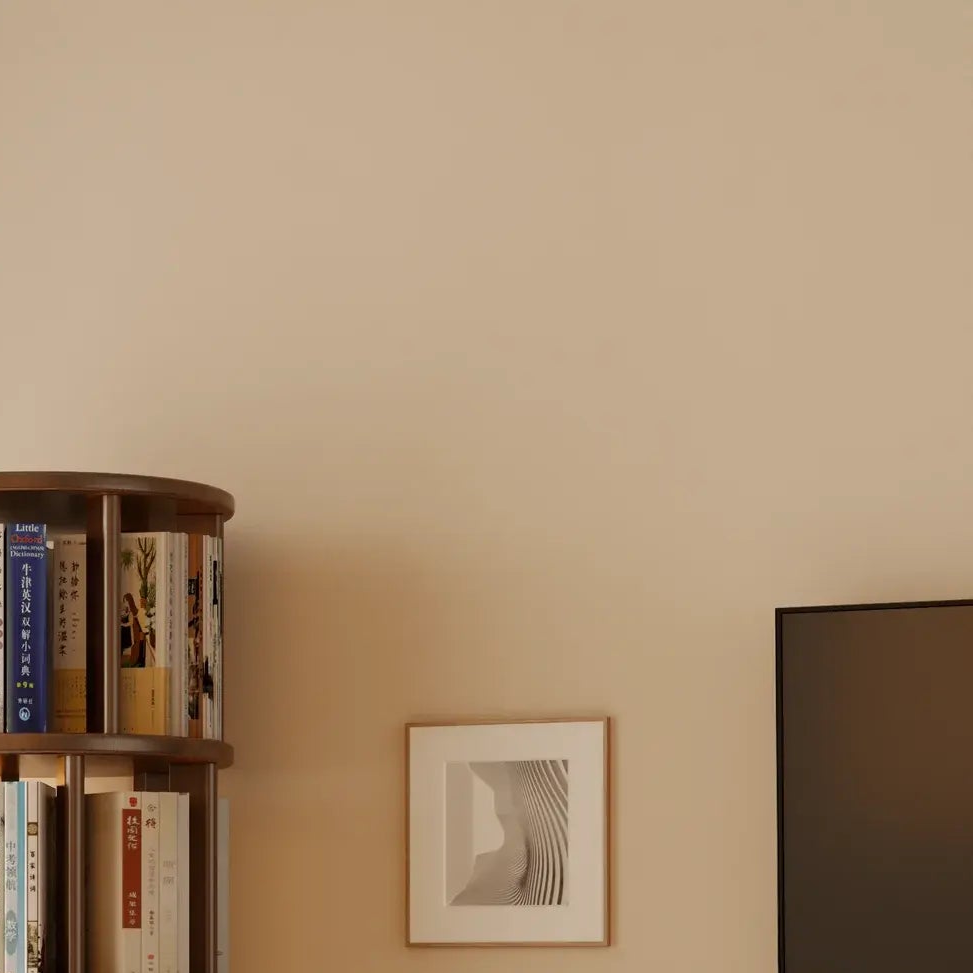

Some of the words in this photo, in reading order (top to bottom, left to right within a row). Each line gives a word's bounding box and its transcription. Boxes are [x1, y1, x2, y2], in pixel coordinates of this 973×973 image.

[16, 523, 39, 533] Little
[10, 534, 43, 544] Oxford
[10, 551, 44, 559] Dictionary
[20, 563, 32, 676] 牛津英汉双解小词典
